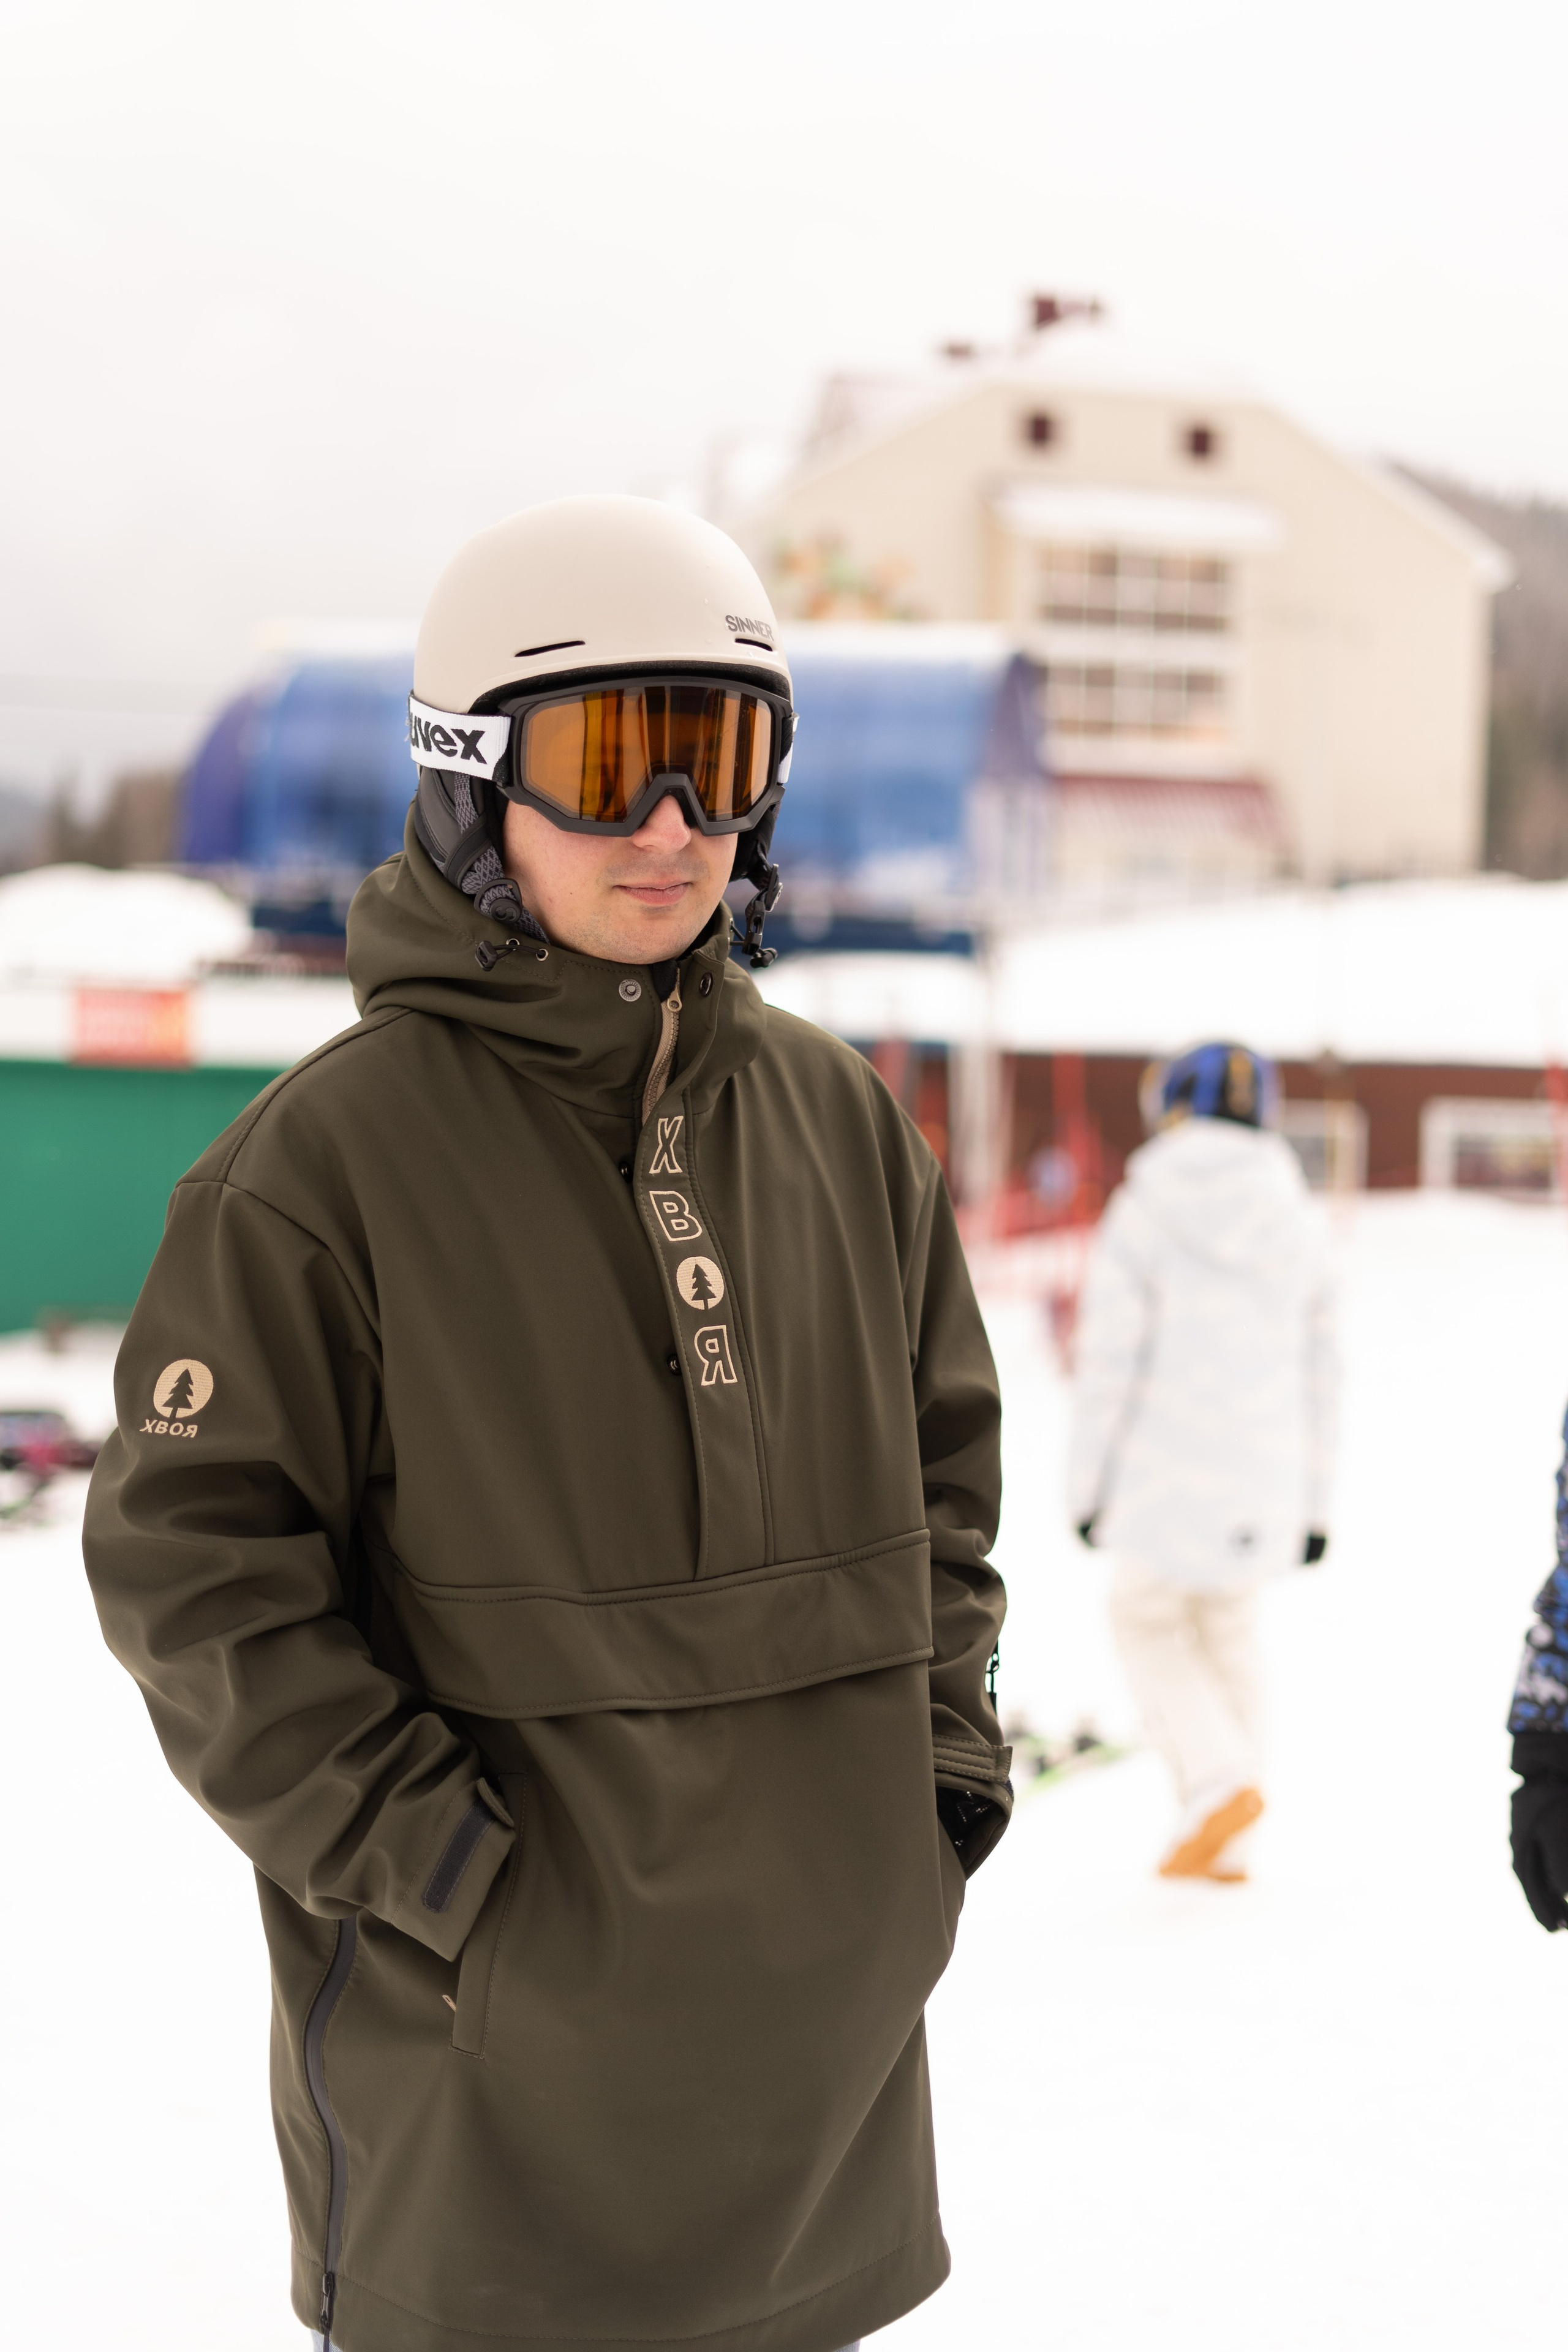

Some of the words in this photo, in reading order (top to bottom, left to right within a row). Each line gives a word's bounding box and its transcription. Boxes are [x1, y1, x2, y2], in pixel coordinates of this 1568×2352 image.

[725, 615, 774, 641] SINNER
[410, 712, 488, 764] uvex
[139, 1419, 198, 1438] ХВОЯ
